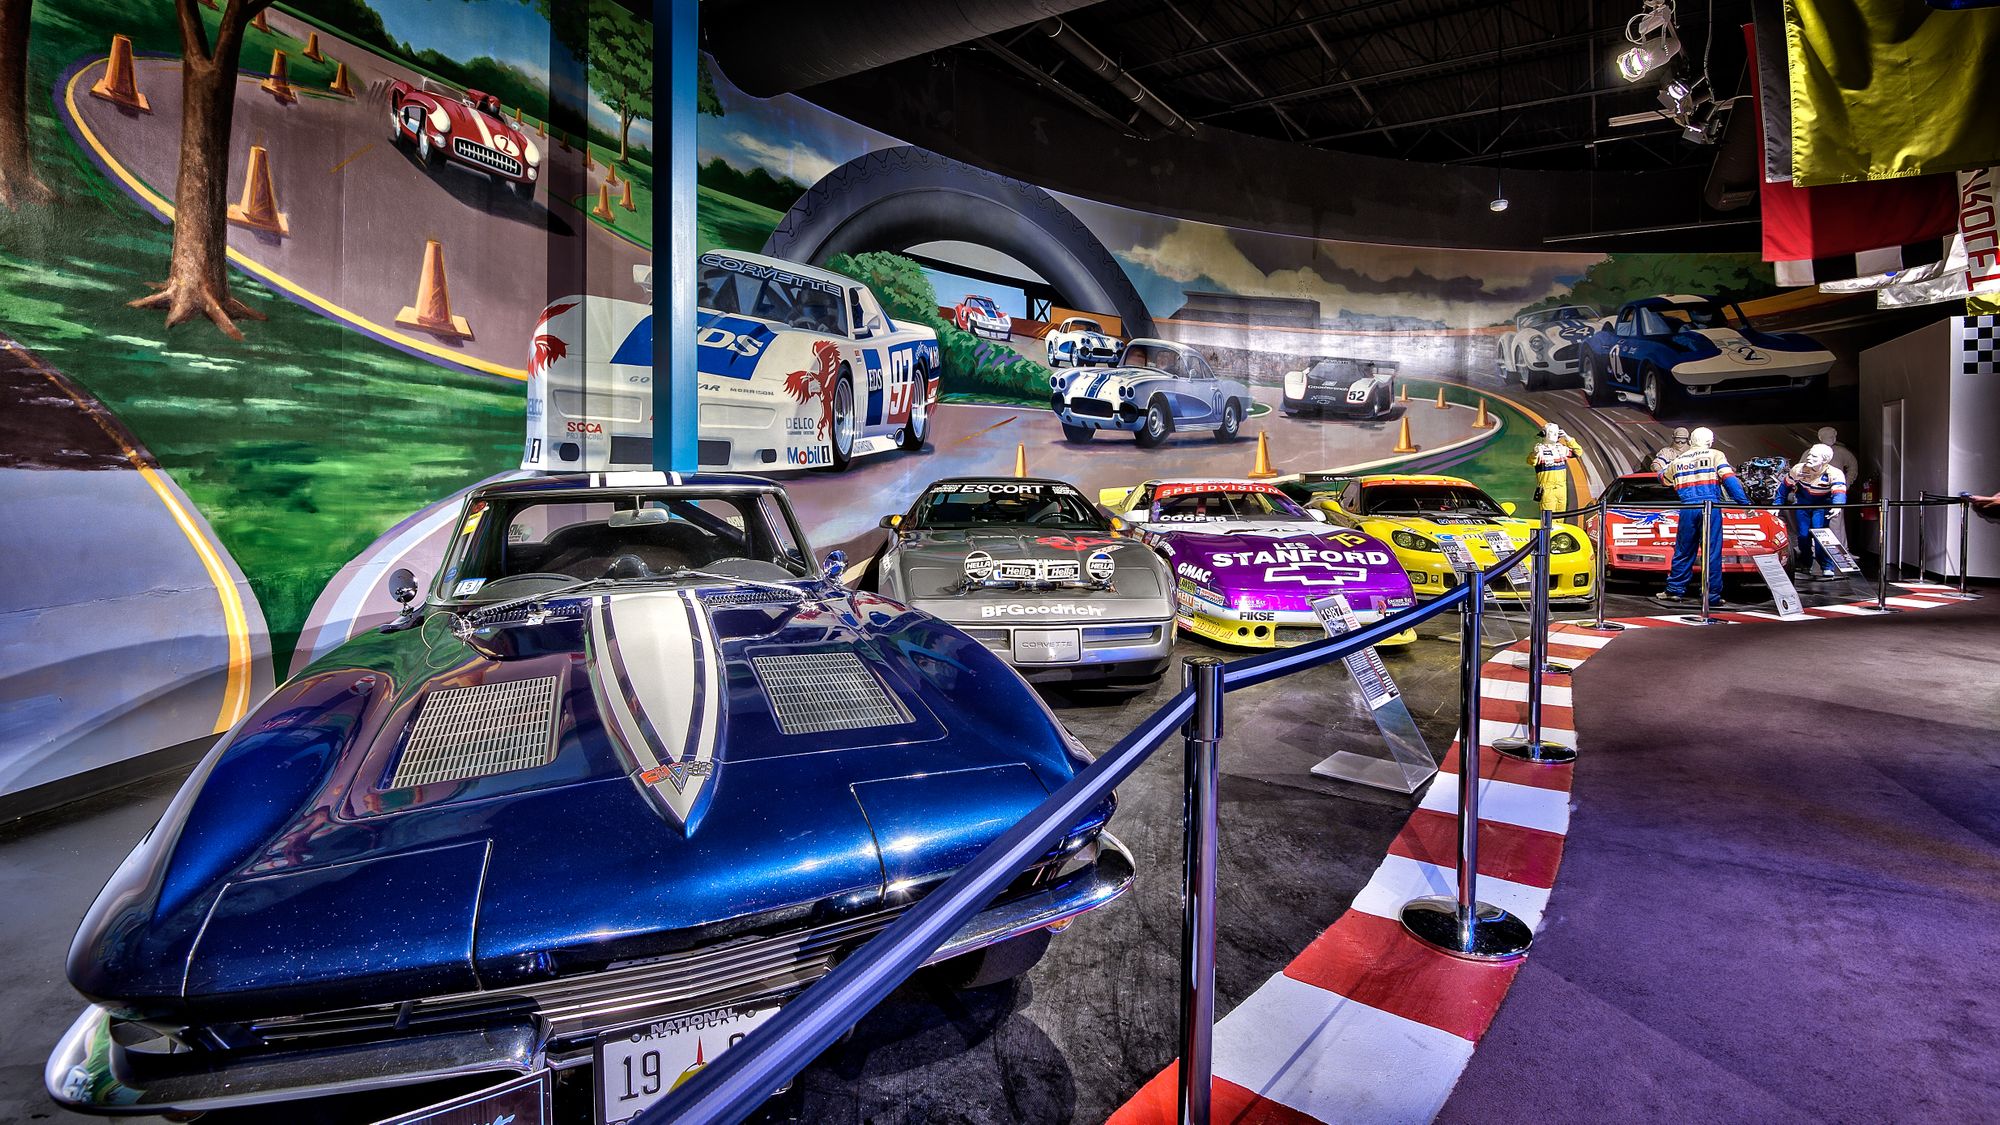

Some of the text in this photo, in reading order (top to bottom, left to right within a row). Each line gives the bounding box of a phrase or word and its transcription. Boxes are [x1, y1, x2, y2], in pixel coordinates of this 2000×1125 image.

[500, 136, 513, 154] 2
[701, 253, 841, 298] CORVETTE
[1561, 327, 1590, 337] 24
[868, 368, 883, 392] EDS
[889, 348, 913, 415] 97
[730, 387, 775, 396] MORRISON
[1348, 391, 1365, 402] 52
[567, 421, 603, 434] SCCA
[786, 418, 815, 430] DELCO
[787, 446, 831, 464] Mobil 1
[960, 484, 1044, 494] ESCORT
[1162, 485, 1279, 496] SPEEDVISION
[1160, 514, 1227, 522] COOPER
[1273, 542, 1310, 550] LES
[1327, 533, 1367, 548] 75
[966, 560, 991, 569] HELLA
[1212, 550, 1390, 567] STANFORD
[1006, 566, 1032, 576] Hella
[1051, 567, 1075, 577] Hella
[1090, 562, 1114, 570] HELLA
[1177, 562, 1212, 583] GMAC
[981, 603, 1103, 618] BFGoodrich
[1240, 611, 1275, 621] FIKSE
[1320, 605, 1342, 620] 1987
[651, 1008, 740, 1035] NATIONAL
[620, 1050, 661, 1101] 19
